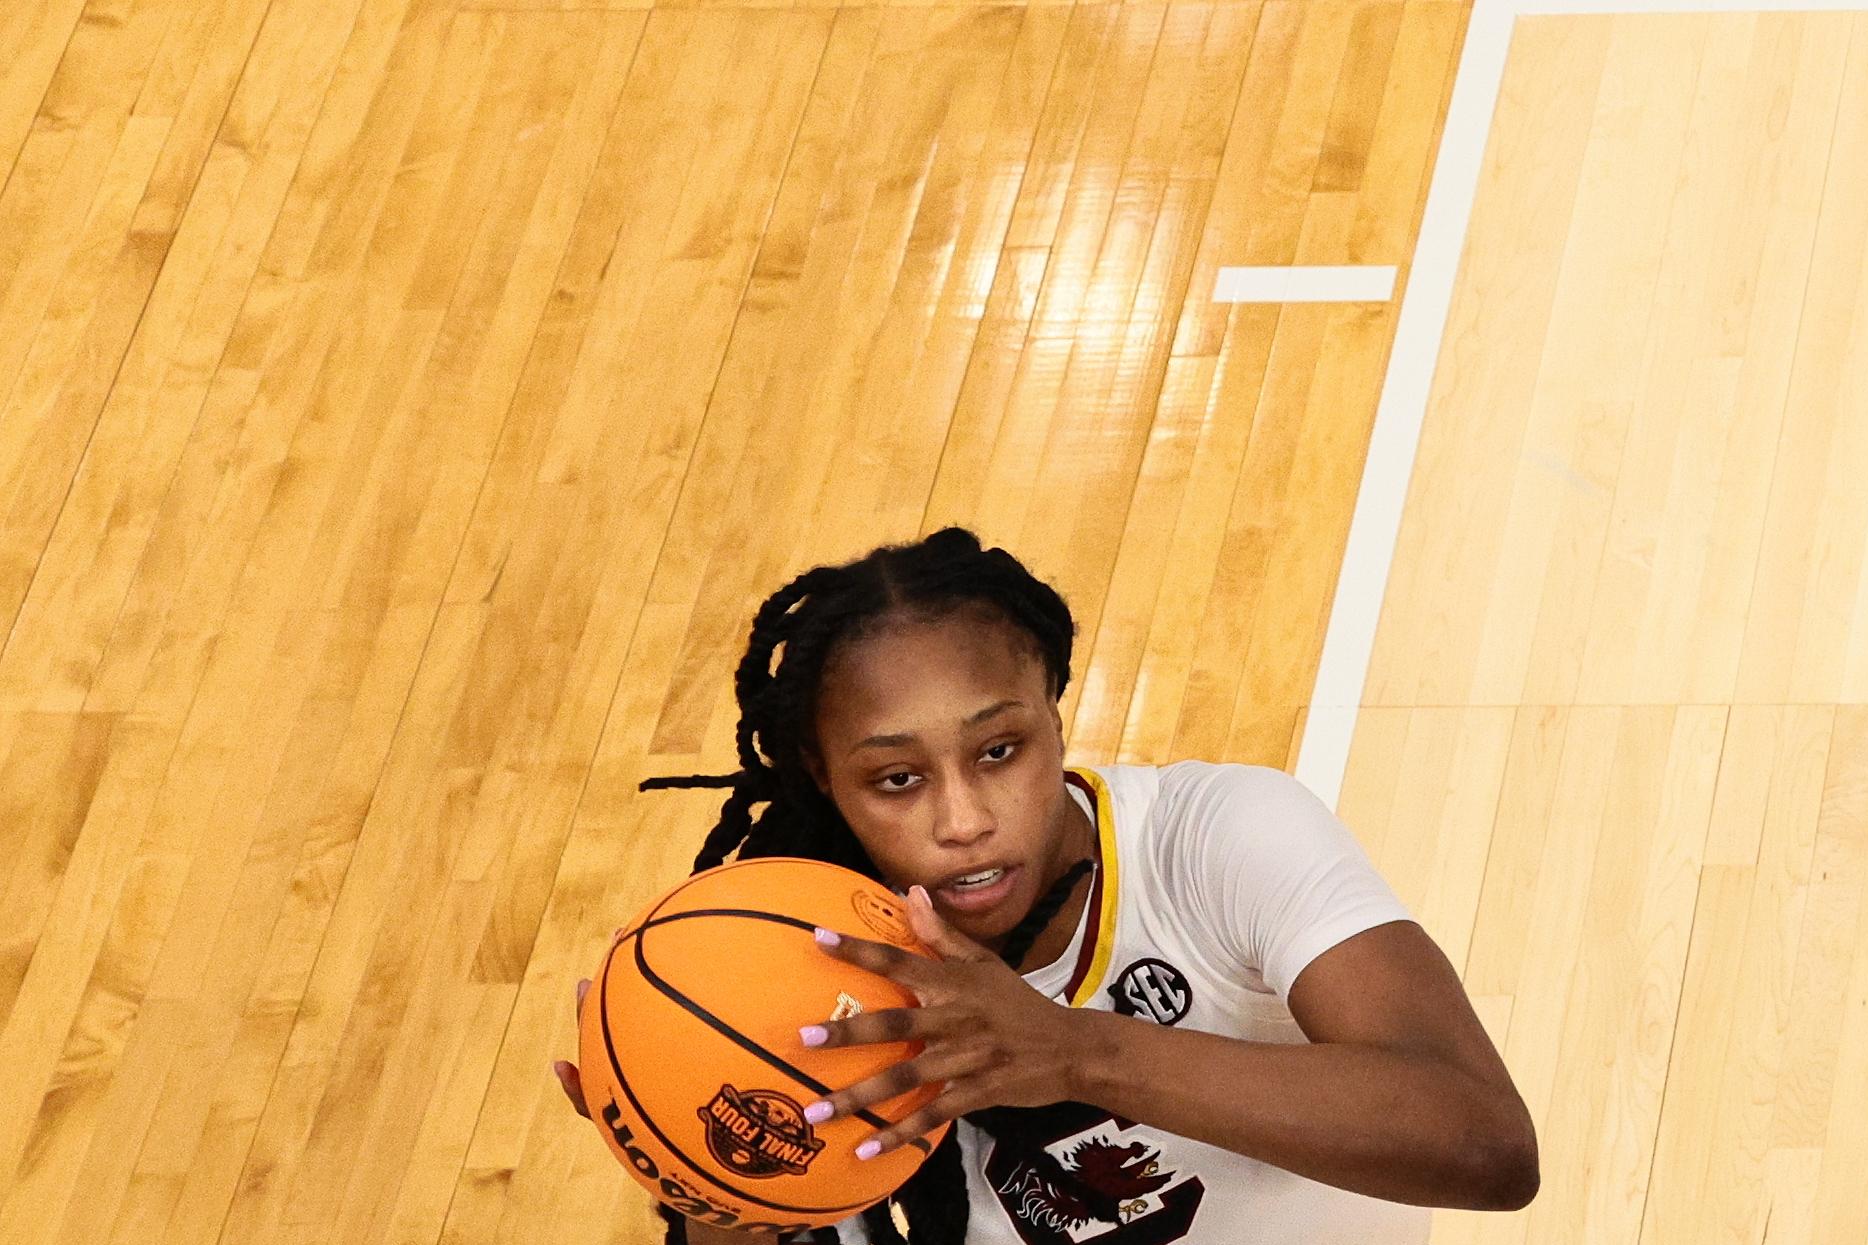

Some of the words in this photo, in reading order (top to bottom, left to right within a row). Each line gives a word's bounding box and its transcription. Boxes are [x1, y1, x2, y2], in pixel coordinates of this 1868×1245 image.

[1122, 963, 1187, 1024] SEC
[710, 1095, 760, 1142] FOUR
[758, 1131, 815, 1166] FINAL
